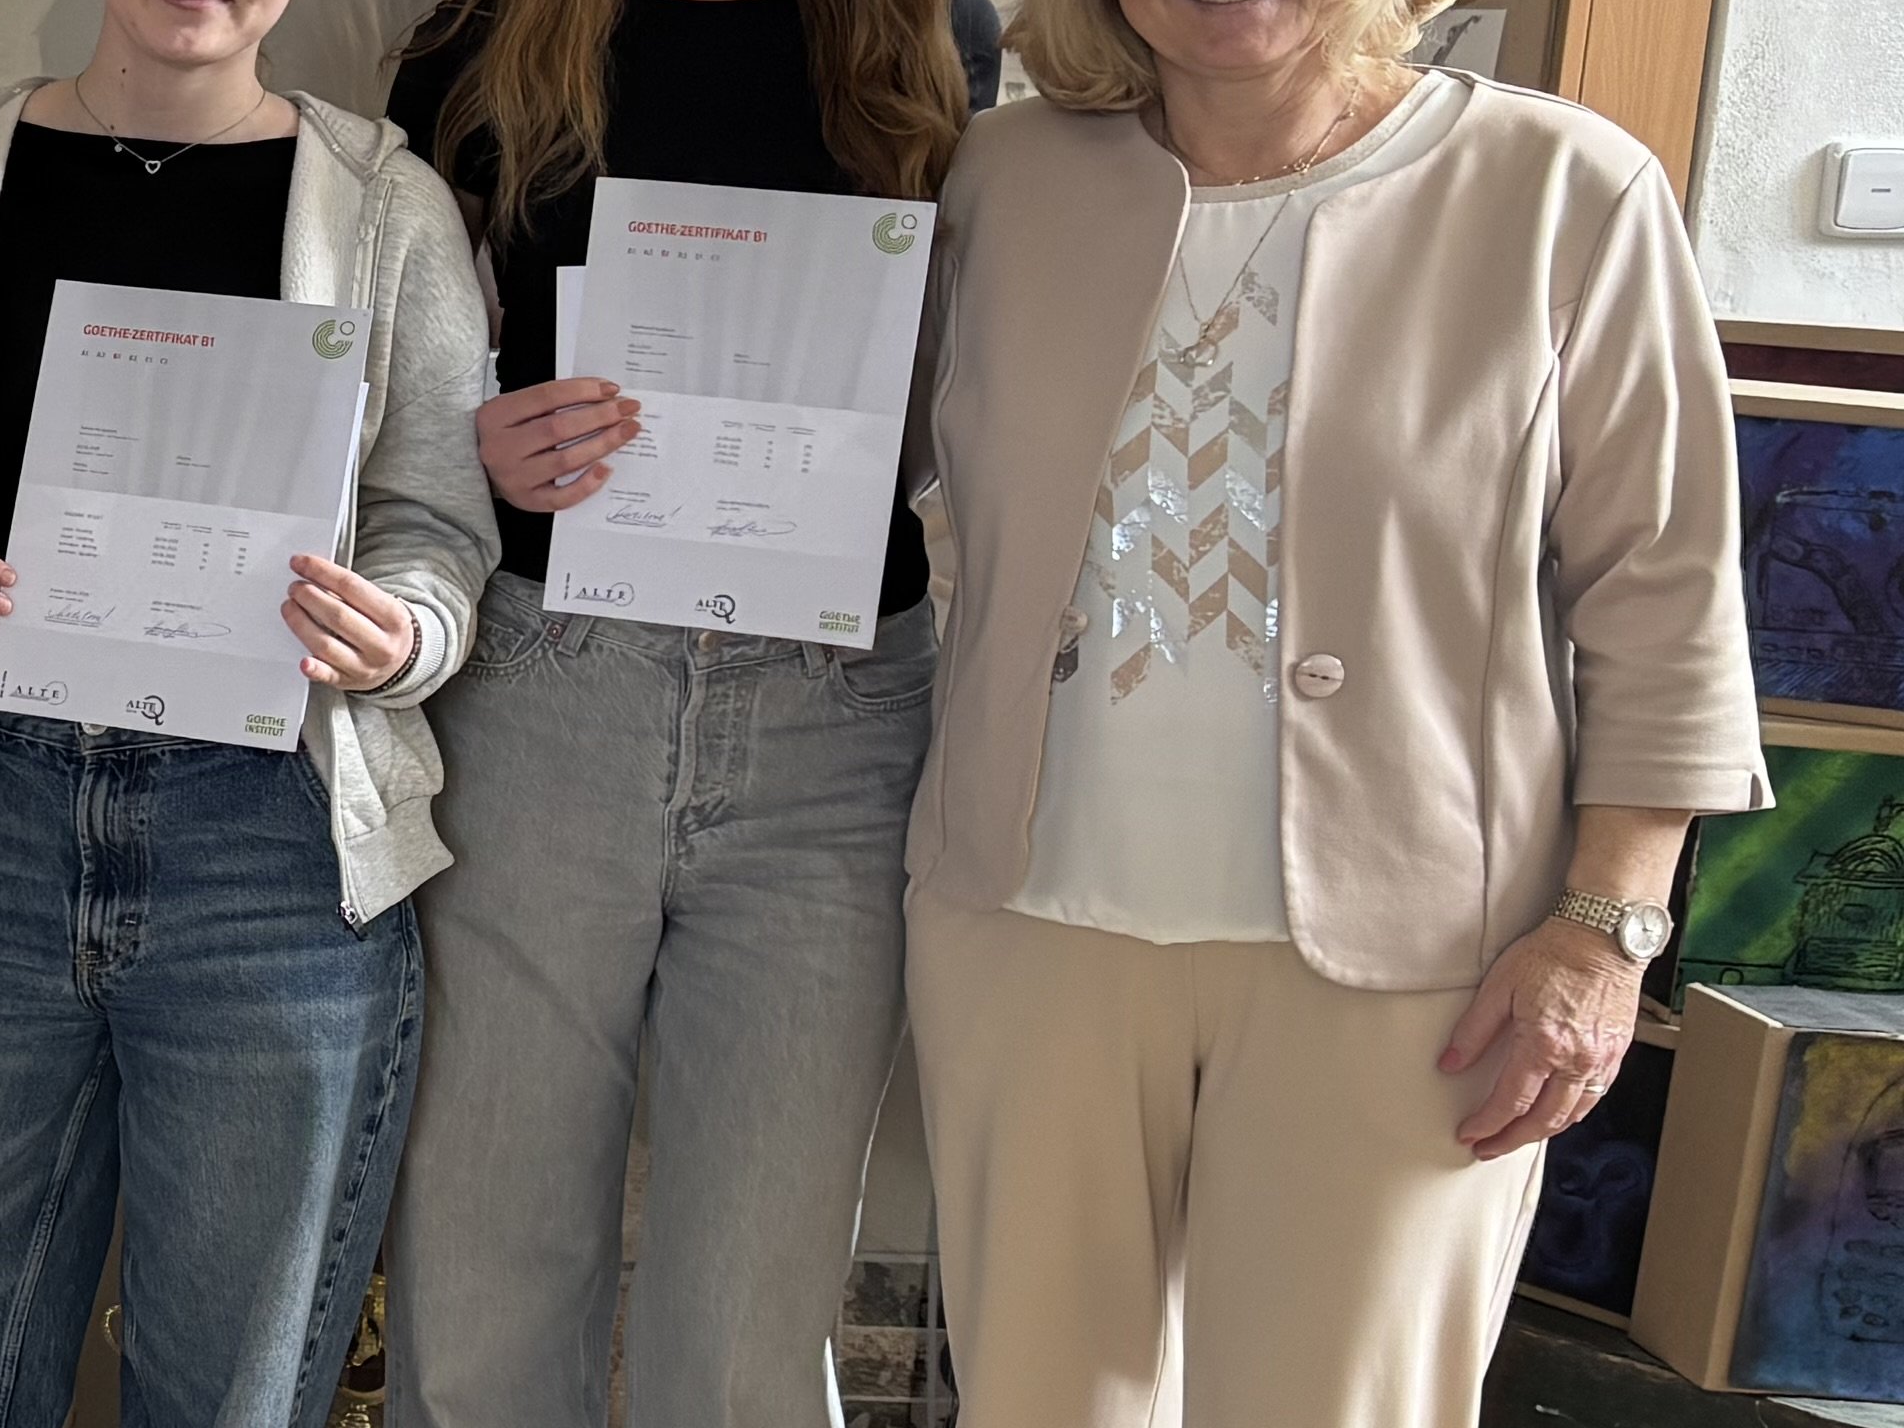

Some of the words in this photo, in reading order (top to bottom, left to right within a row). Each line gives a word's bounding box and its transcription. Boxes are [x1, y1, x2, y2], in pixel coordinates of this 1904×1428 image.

[628, 221, 751, 242] GOETHE-ZERTIFIKAT
[83, 324, 200, 346] GOETHE-ZERTIFIKAT
[201, 335, 215, 348] B1
[246, 713, 286, 727] GOETHE
